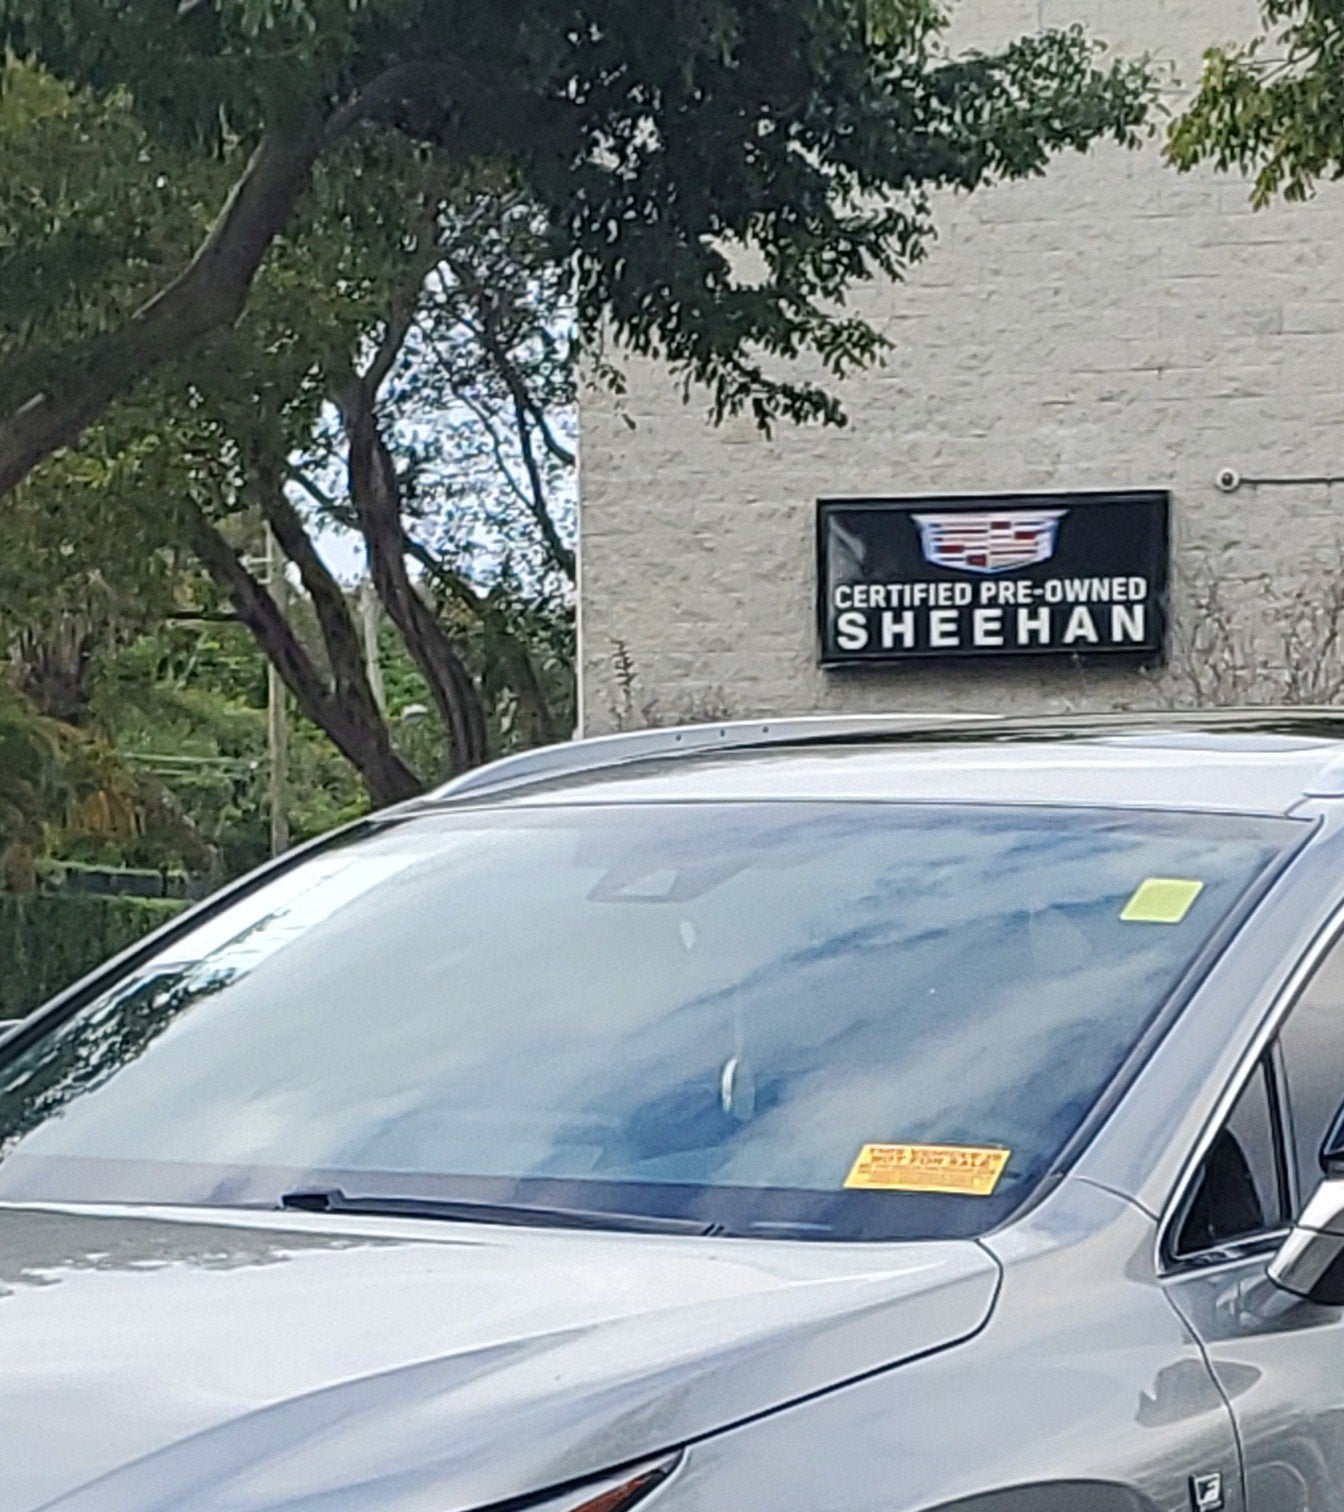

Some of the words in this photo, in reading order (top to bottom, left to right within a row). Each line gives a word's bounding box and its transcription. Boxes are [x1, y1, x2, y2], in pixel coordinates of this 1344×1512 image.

[834, 582, 973, 609] CERTIFIED
[979, 576, 1148, 605] PRE-OWNED
[836, 604, 1146, 650] SHEEHAN
